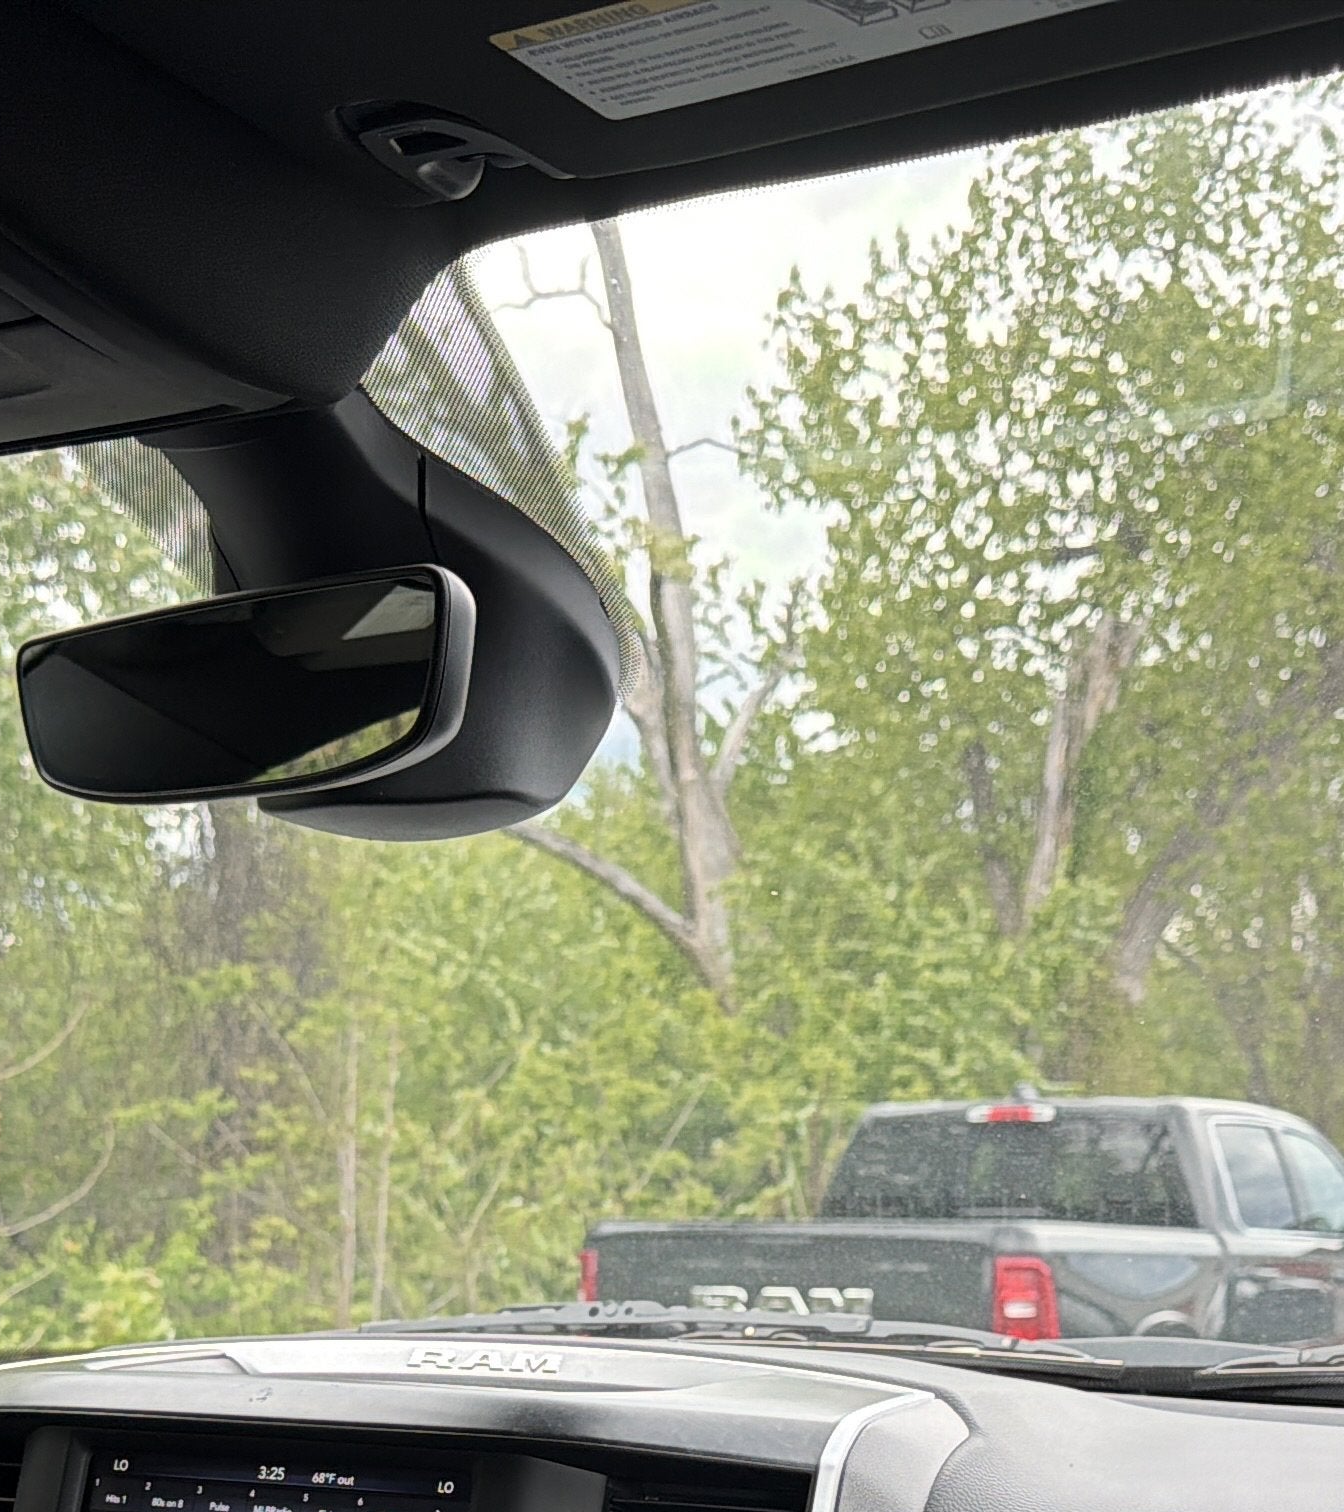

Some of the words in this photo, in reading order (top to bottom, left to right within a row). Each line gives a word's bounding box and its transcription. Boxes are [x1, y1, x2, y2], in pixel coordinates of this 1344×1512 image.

[406, 1348, 563, 1374] RAM
[113, 1459, 129, 1472] LO
[258, 1466, 285, 1480] 3:25
[337, 1475, 355, 1486] out
[145, 1482, 152, 1490] 2
[197, 1486, 203, 1494] 3
[437, 1481, 454, 1494] LO
[248, 1489, 255, 1498] 4
[303, 1493, 309, 1502] 5
[358, 1498, 364, 1506] 6
[209, 1502, 230, 1512] Pulse
